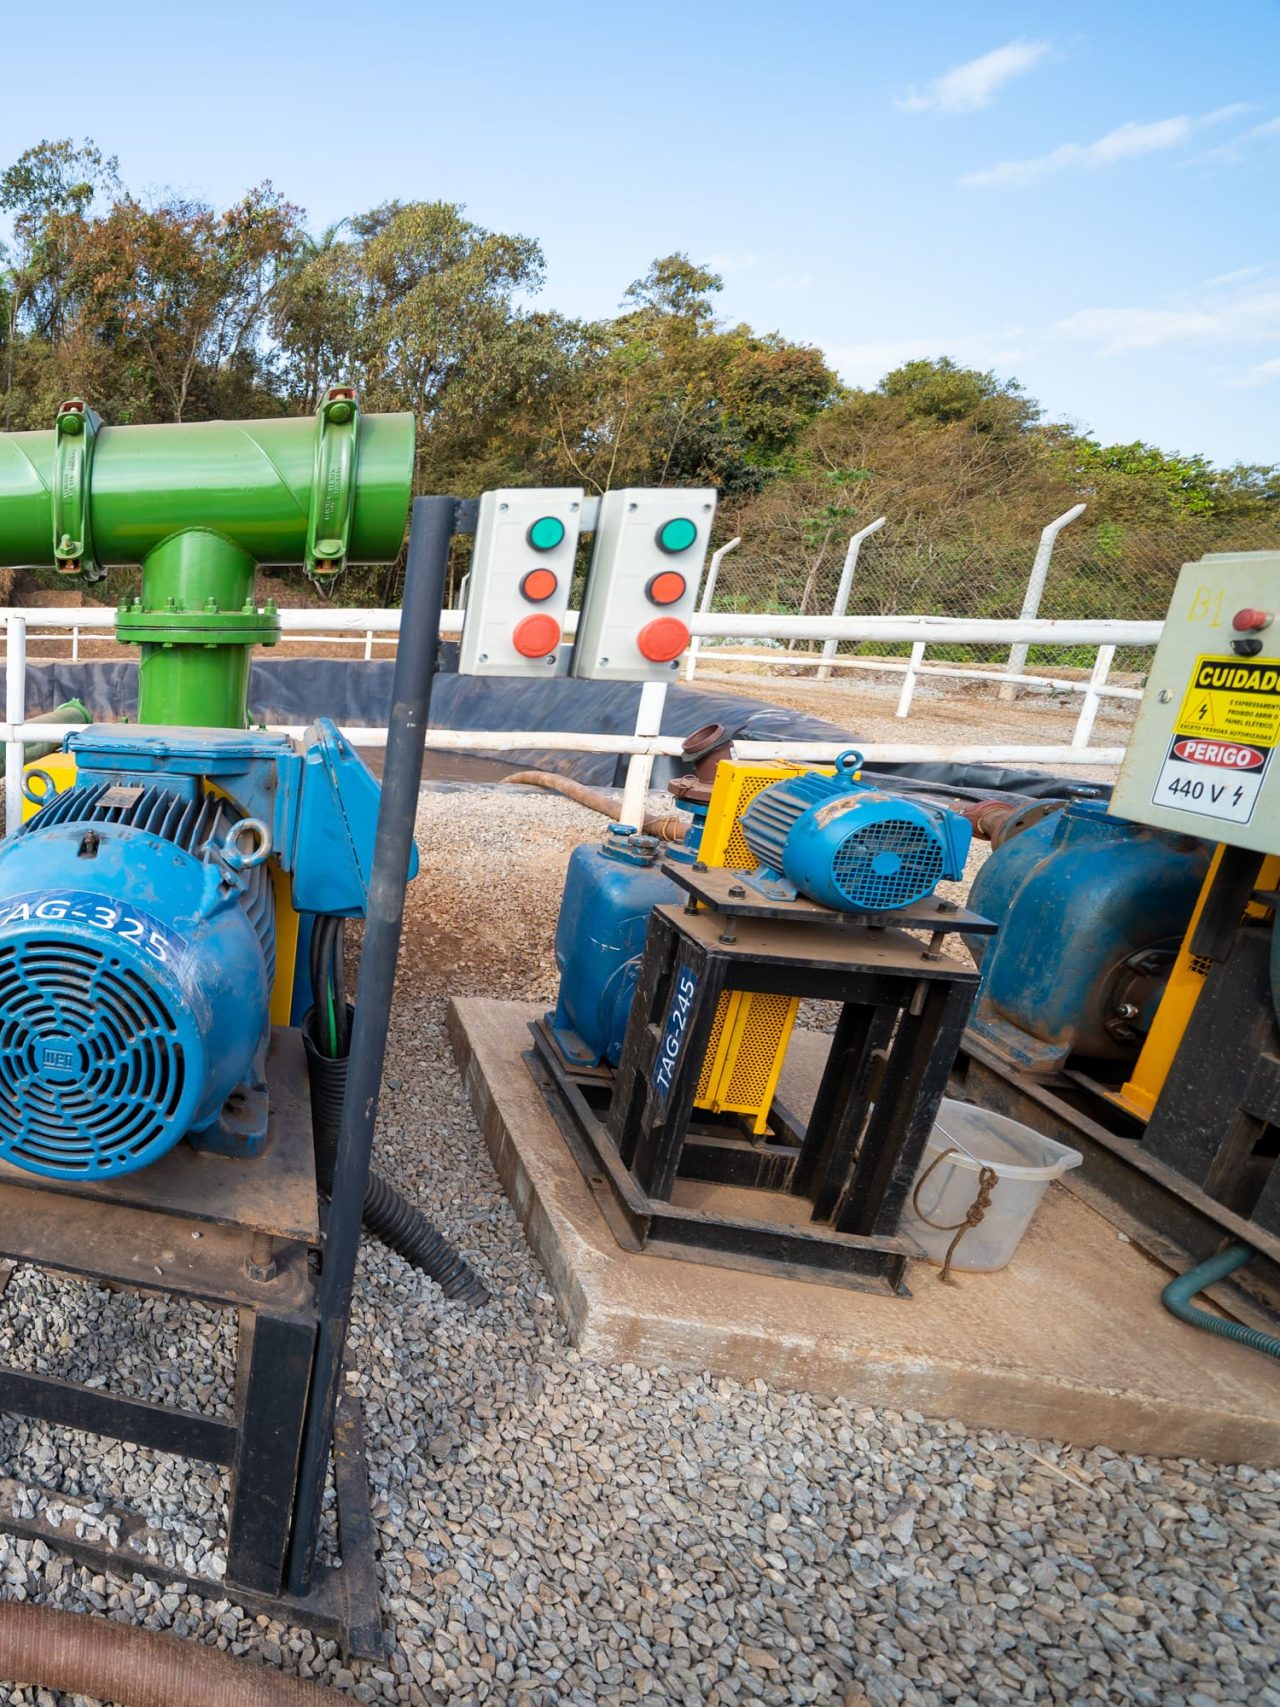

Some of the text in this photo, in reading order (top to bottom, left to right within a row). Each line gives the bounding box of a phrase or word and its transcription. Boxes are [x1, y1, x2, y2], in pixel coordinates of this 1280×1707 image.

[1187, 584, 1224, 628] B1
[1235, 700, 1280, 710] EXPRESSAMENT
[1202, 726, 1228, 735] PESSOAS
[1229, 730, 1272, 741] AUTORIZADAS
[1225, 718, 1243, 726] PAINEL
[1183, 742, 1252, 766] PERIGO
[1168, 778, 1225, 803] 440 V
[657, 977, 694, 1089] TAG-245
